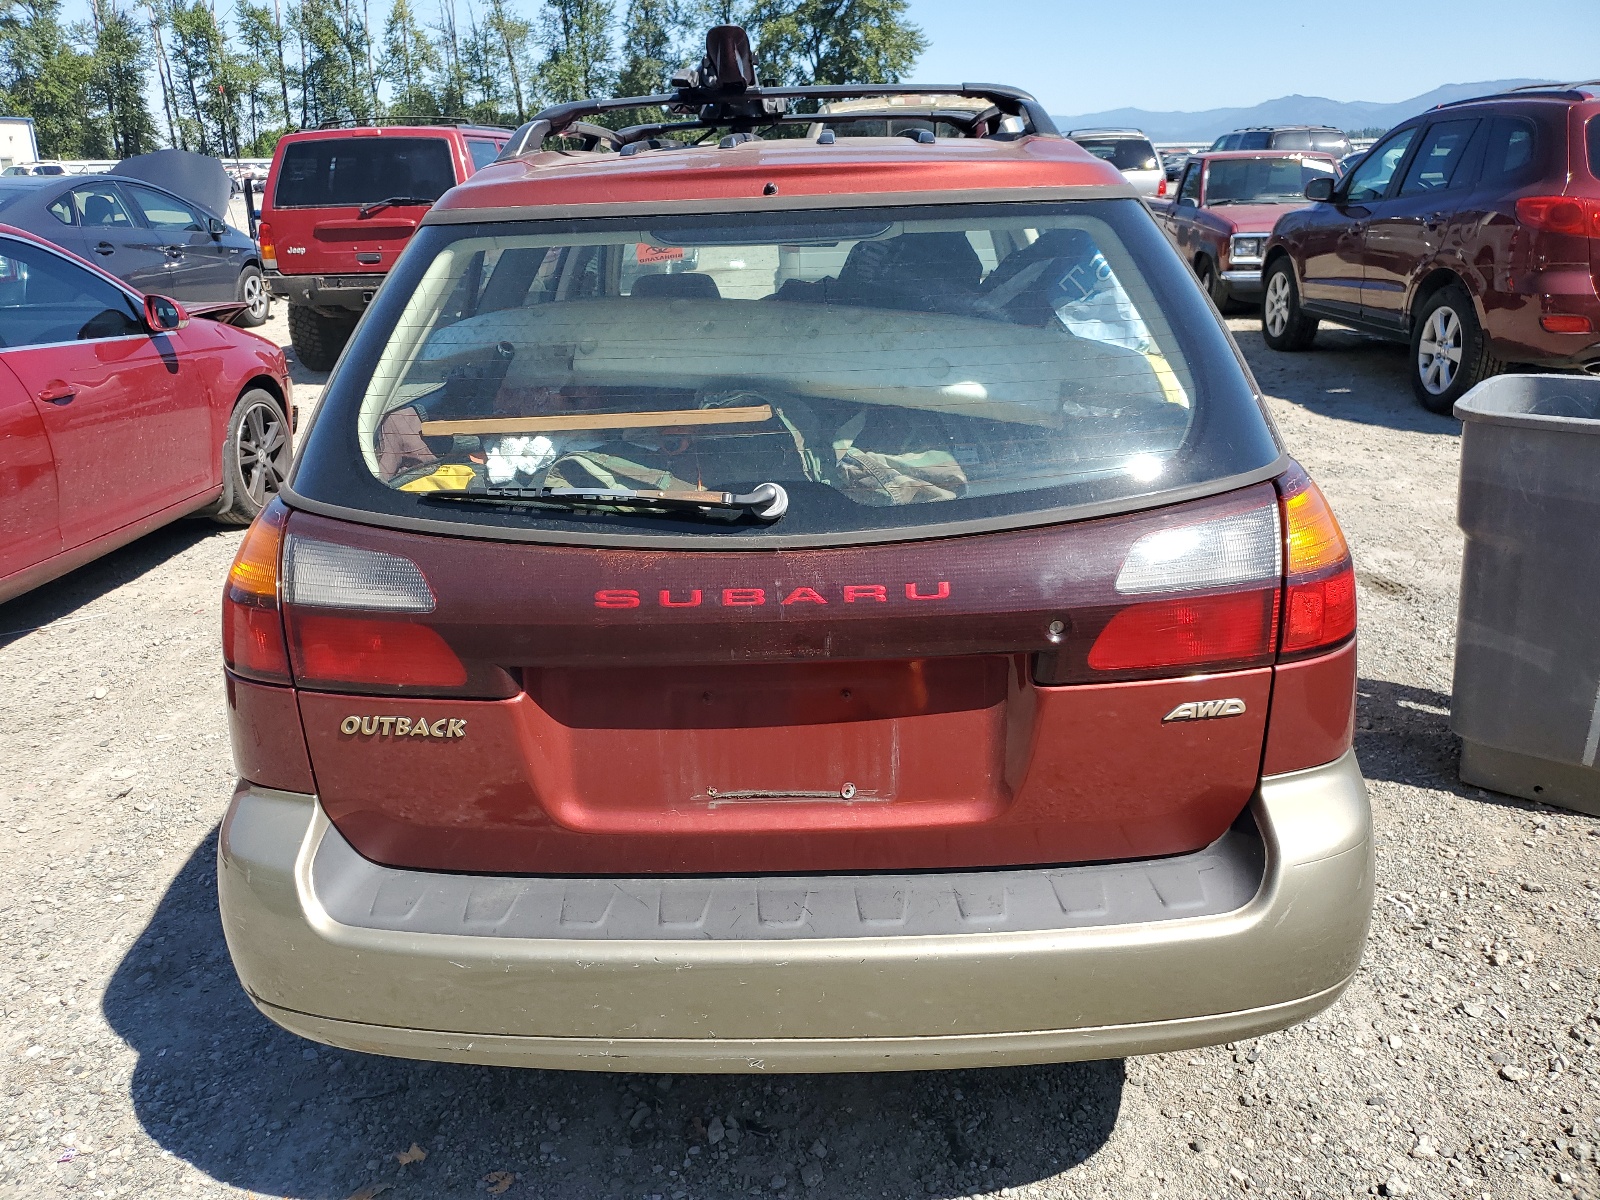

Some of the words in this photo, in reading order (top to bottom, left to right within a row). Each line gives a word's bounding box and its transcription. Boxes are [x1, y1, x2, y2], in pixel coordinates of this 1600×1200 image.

[287, 246, 306, 255] Jeep
[593, 581, 951, 609] SUBARU
[1161, 698, 1247, 721] AWD
[340, 715, 468, 738] OUTBACK
